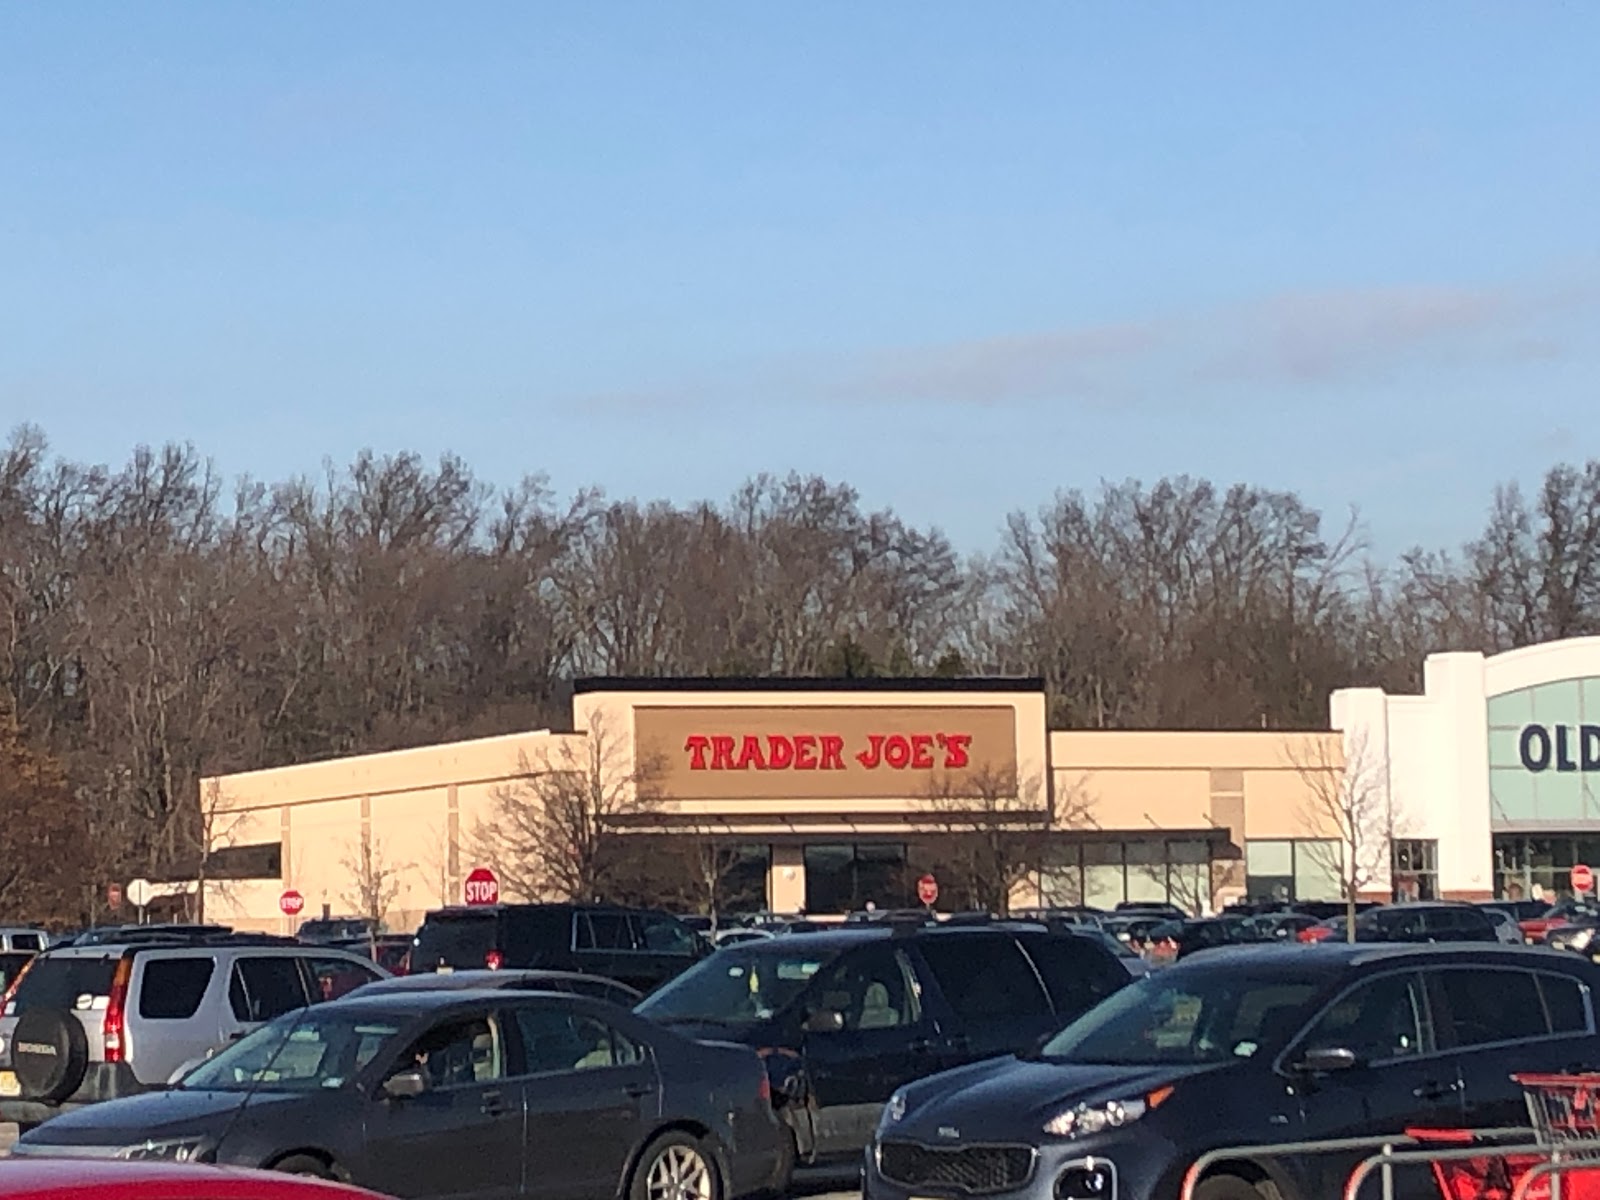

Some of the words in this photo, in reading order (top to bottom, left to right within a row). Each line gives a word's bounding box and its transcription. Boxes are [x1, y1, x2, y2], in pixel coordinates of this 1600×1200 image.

[684, 735, 847, 770] TRADER
[856, 732, 972, 769] JOE'S
[1519, 723, 1600, 773] OLD
[466, 881, 497, 902] STOP
